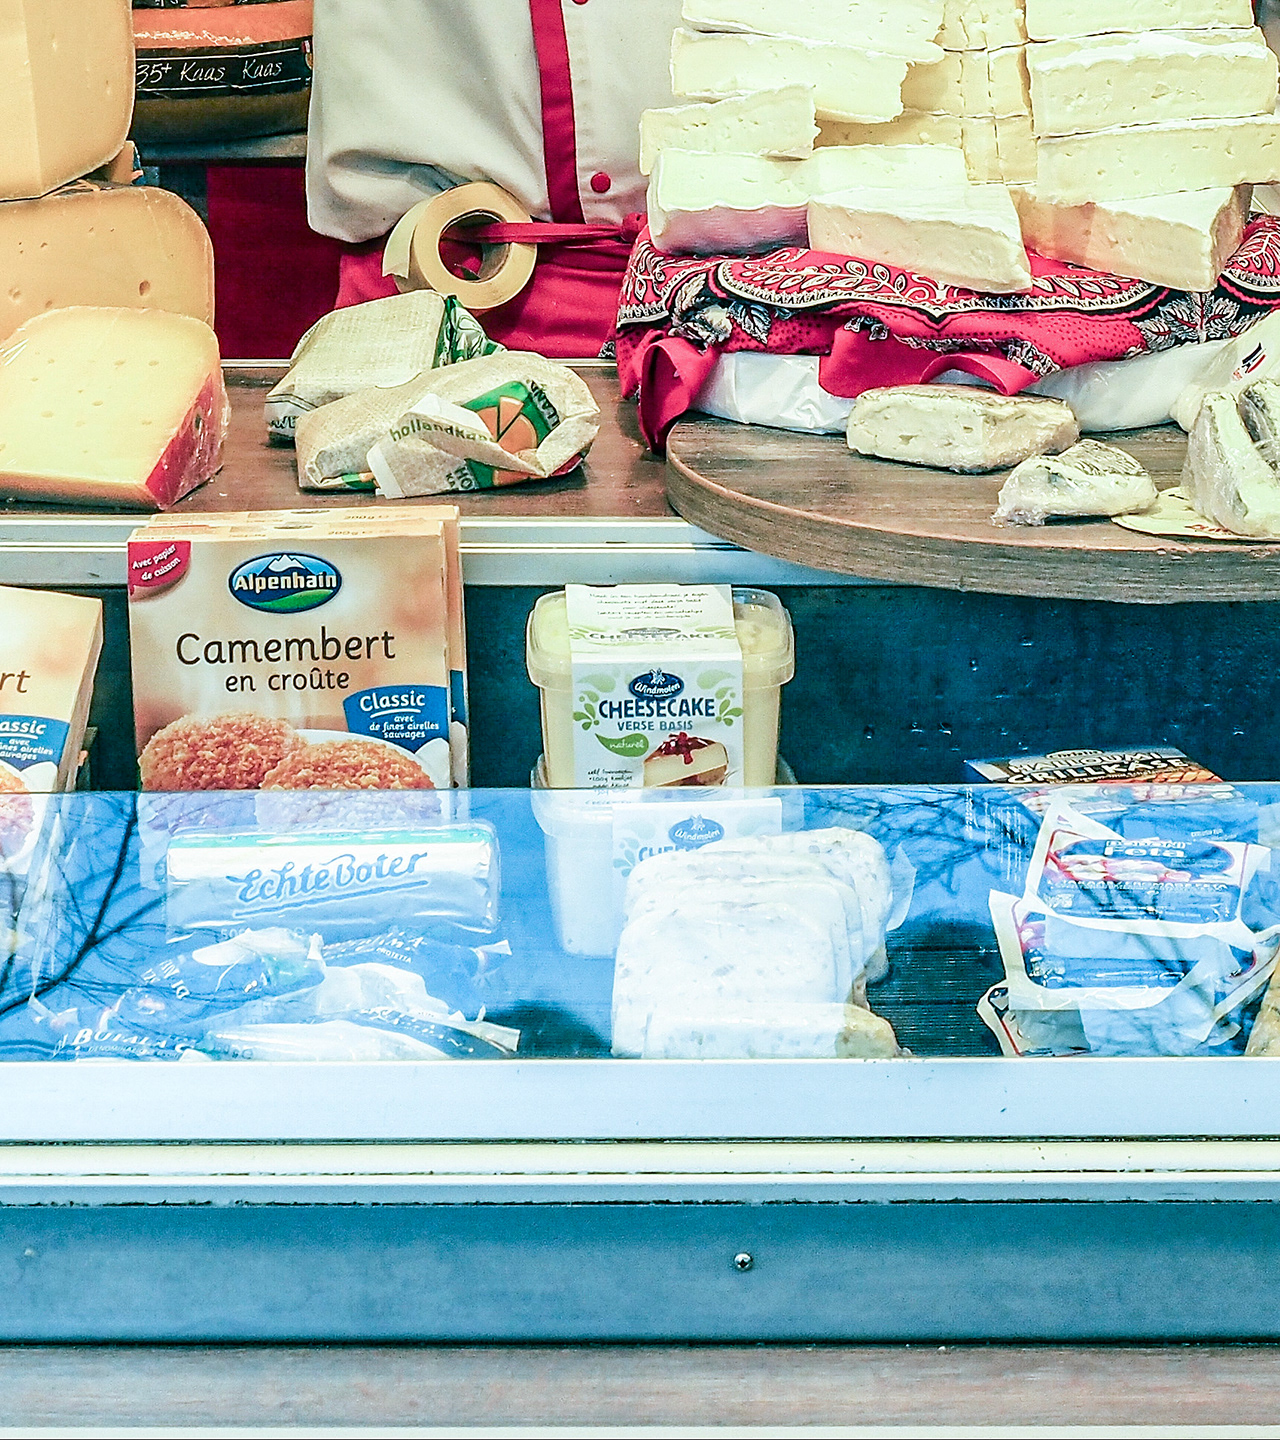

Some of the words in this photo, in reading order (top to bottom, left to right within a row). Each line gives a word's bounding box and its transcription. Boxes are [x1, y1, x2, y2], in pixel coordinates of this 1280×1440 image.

[136, 62, 172, 85] 35+
[180, 60, 226, 82] Kaas
[242, 58, 283, 80] Kaas
[132, 556, 153, 571] Avec
[153, 544, 177, 564] papier
[141, 571, 152, 581] de
[152, 556, 181, 578] cuisson
[233, 571, 337, 594] Alpenhain
[175, 626, 396, 665] Camembert
[225, 673, 256, 692] en
[267, 667, 350, 691] croûte
[633, 679, 682, 696] Windmolen
[359, 690, 425, 712] Classic
[598, 696, 716, 720] CHEESECAKE
[369, 722, 381, 731] de
[382, 722, 405, 732] fines
[406, 720, 439, 731] airelles
[394, 714, 414, 723] avec
[617, 720, 655, 732] VERSE
[659, 720, 694, 732] BASIS
[384, 729, 426, 740] sauvages
[609, 738, 645, 750] naturel
[1009, 751, 1162, 775] HALLOUMI
[674, 826, 722, 842] Windmolen
[1103, 847, 1186, 857] Feta
[226, 861, 328, 906] Echte
[326, 851, 428, 889] Boter
